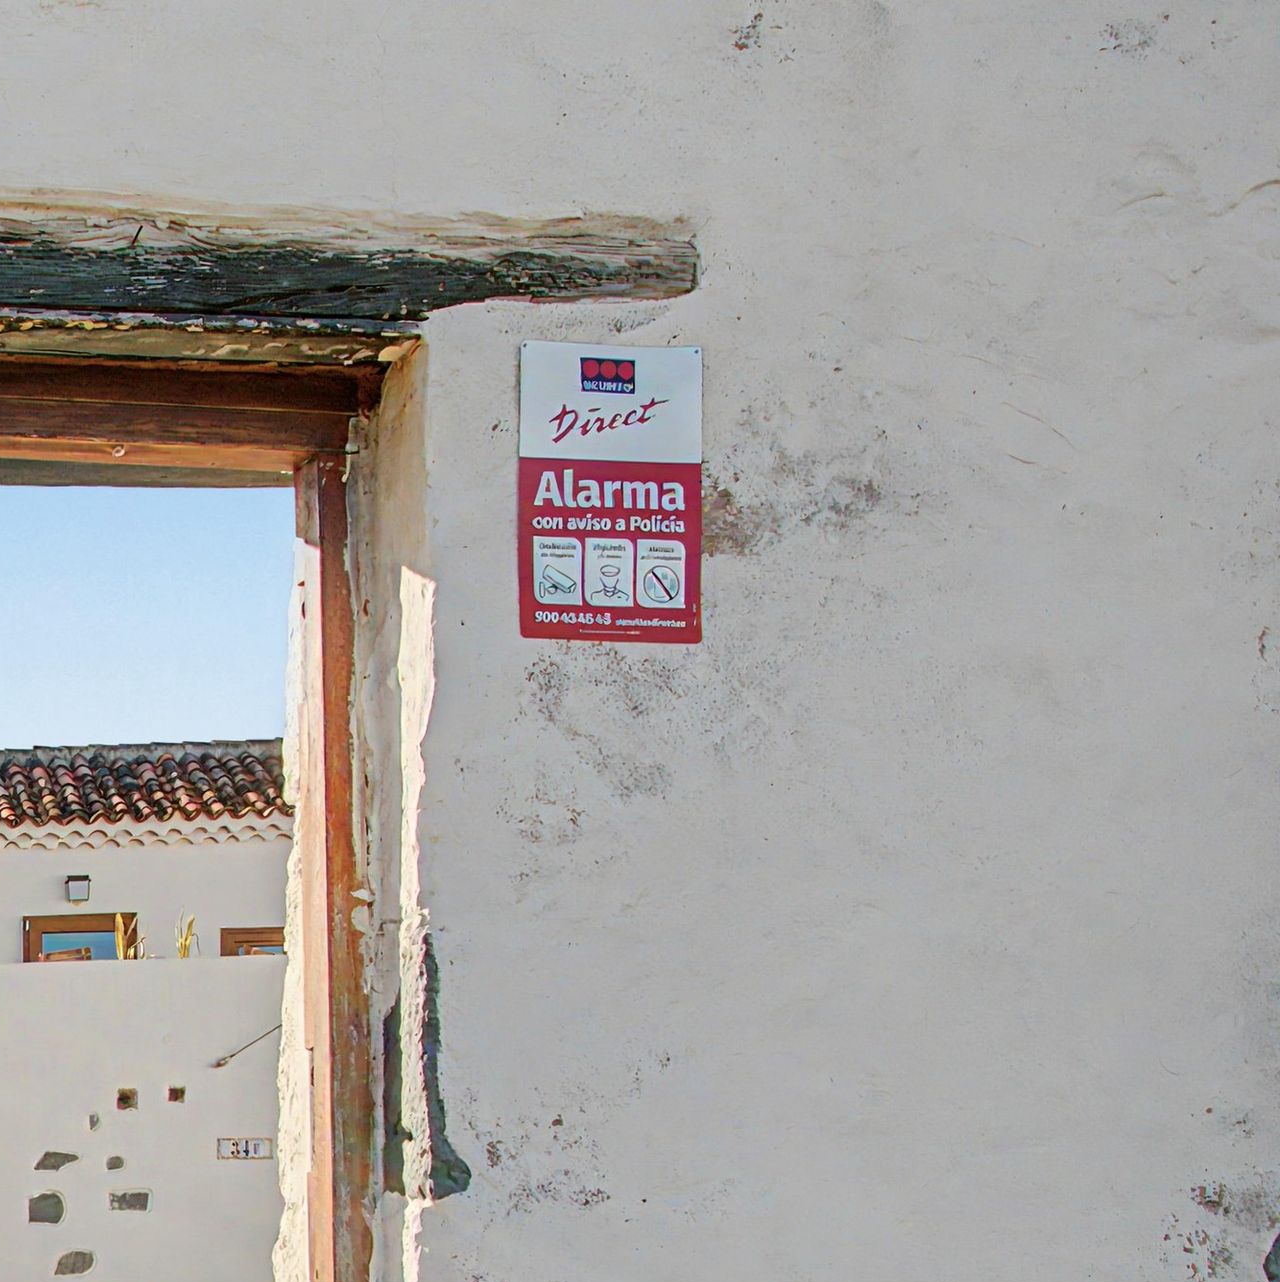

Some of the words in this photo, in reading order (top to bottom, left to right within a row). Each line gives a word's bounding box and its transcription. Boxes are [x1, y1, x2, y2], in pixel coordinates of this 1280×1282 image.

[549, 397, 671, 443] Direct
[533, 469, 686, 511] Alarma
[532, 516, 563, 530] con
[567, 513, 612, 531] aviso
[615, 518, 626, 531] a
[629, 514, 686, 533] Policía
